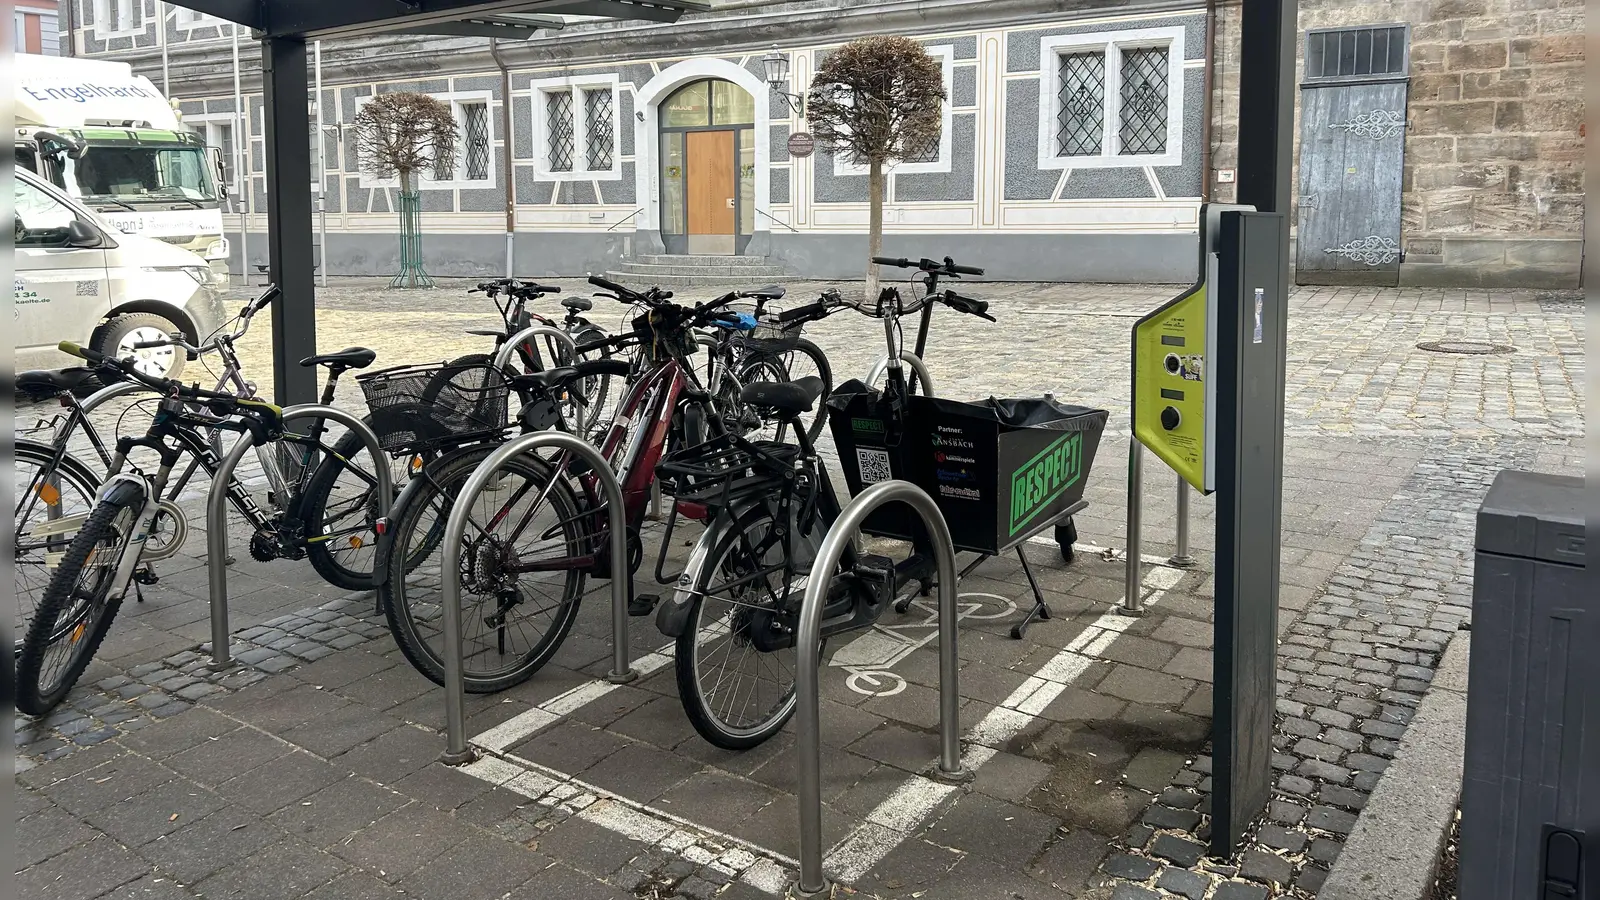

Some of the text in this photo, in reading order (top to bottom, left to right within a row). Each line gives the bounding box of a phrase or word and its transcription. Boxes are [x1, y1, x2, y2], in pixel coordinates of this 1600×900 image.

[853, 420, 882, 431] RESPECT
[937, 425, 963, 434] Partner:
[937, 436, 974, 448] ANSBACH
[1014, 434, 1080, 522] RESPECT
